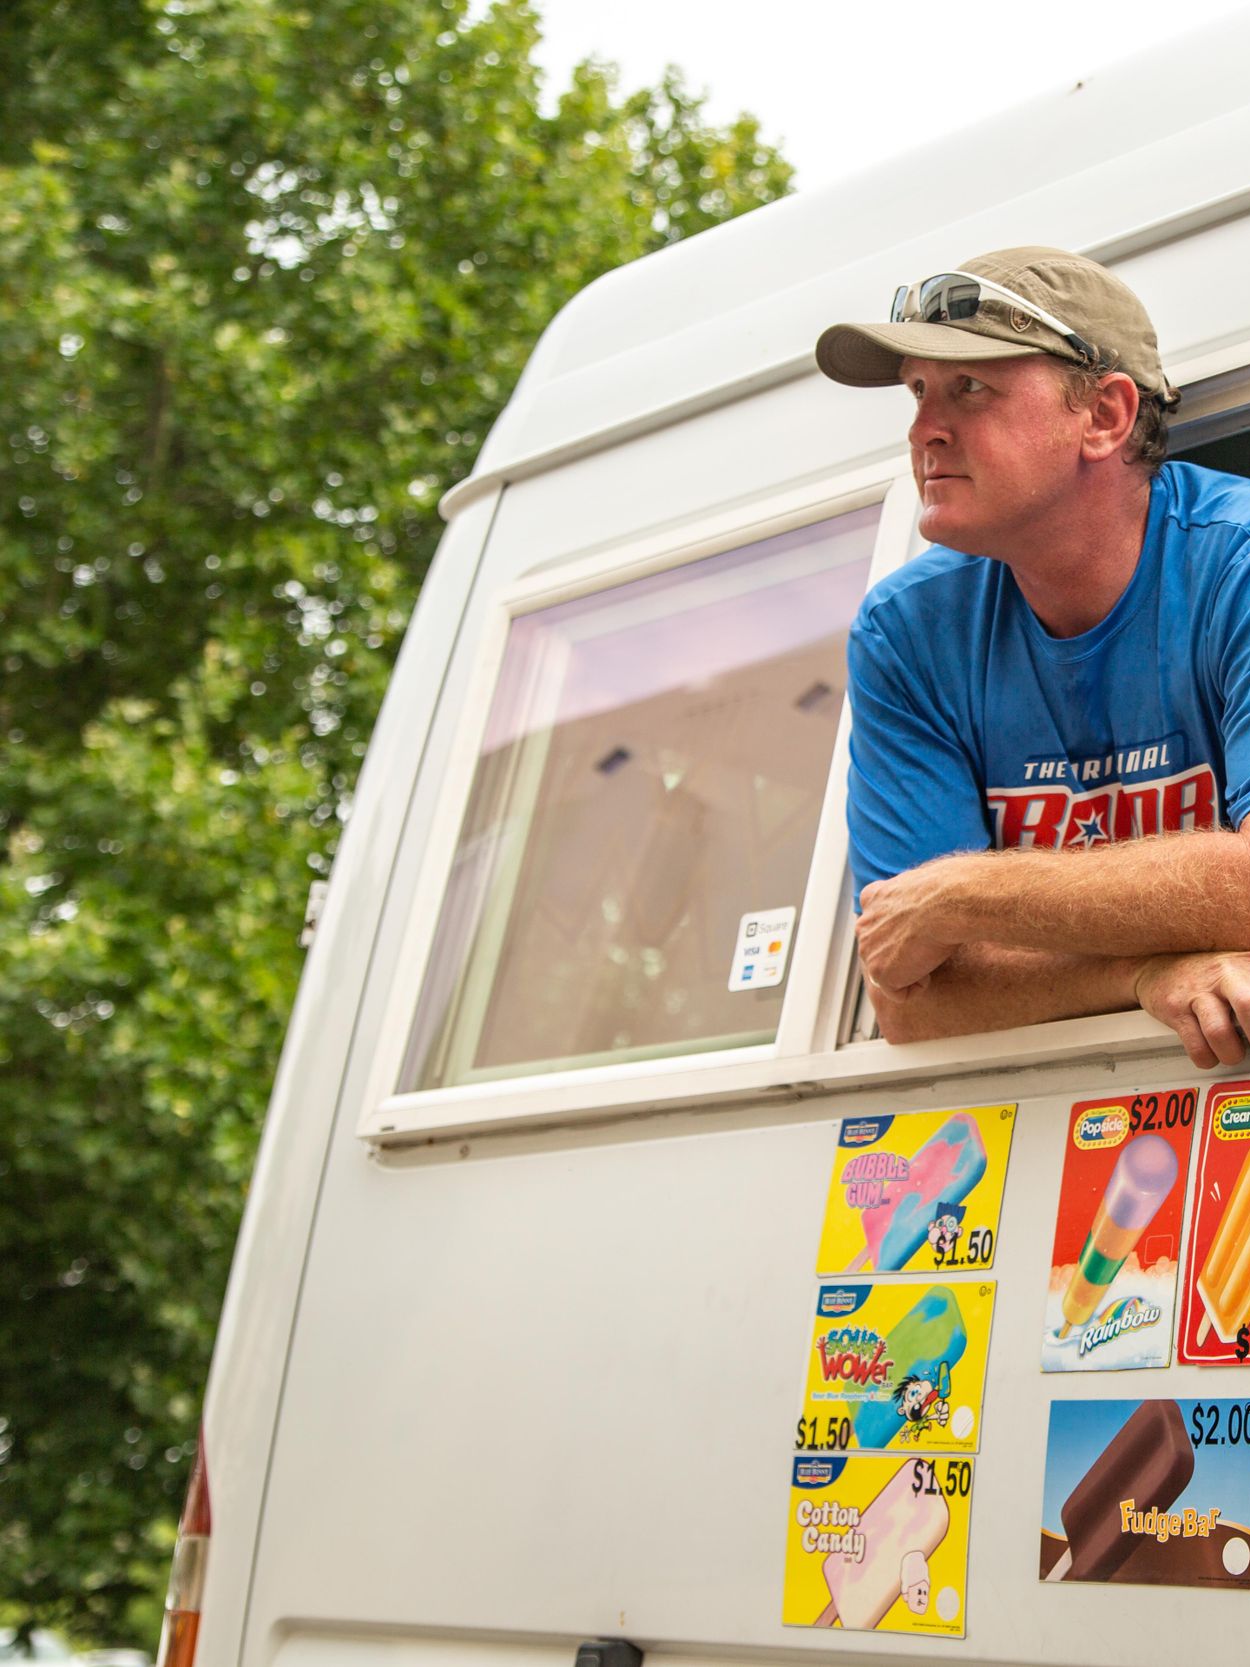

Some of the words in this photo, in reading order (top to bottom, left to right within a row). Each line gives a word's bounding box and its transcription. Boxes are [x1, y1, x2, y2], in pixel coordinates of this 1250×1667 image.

[1024, 761, 1068, 780] THE
[1071, 744, 1170, 781] RIINAL
[1080, 1118, 1123, 1136] Popsicle
[1129, 1091, 1195, 1136] $2.00
[842, 1153, 910, 1184] BUBBLE
[846, 1182, 884, 1208] GUM
[934, 1230, 993, 1270] $1.50
[1080, 1304, 1161, 1359] Rainbow
[796, 1415, 851, 1450] $1.50
[912, 1459, 971, 1498] $1.50
[796, 1500, 860, 1527] Cotton
[802, 1526, 866, 1564] Candy
